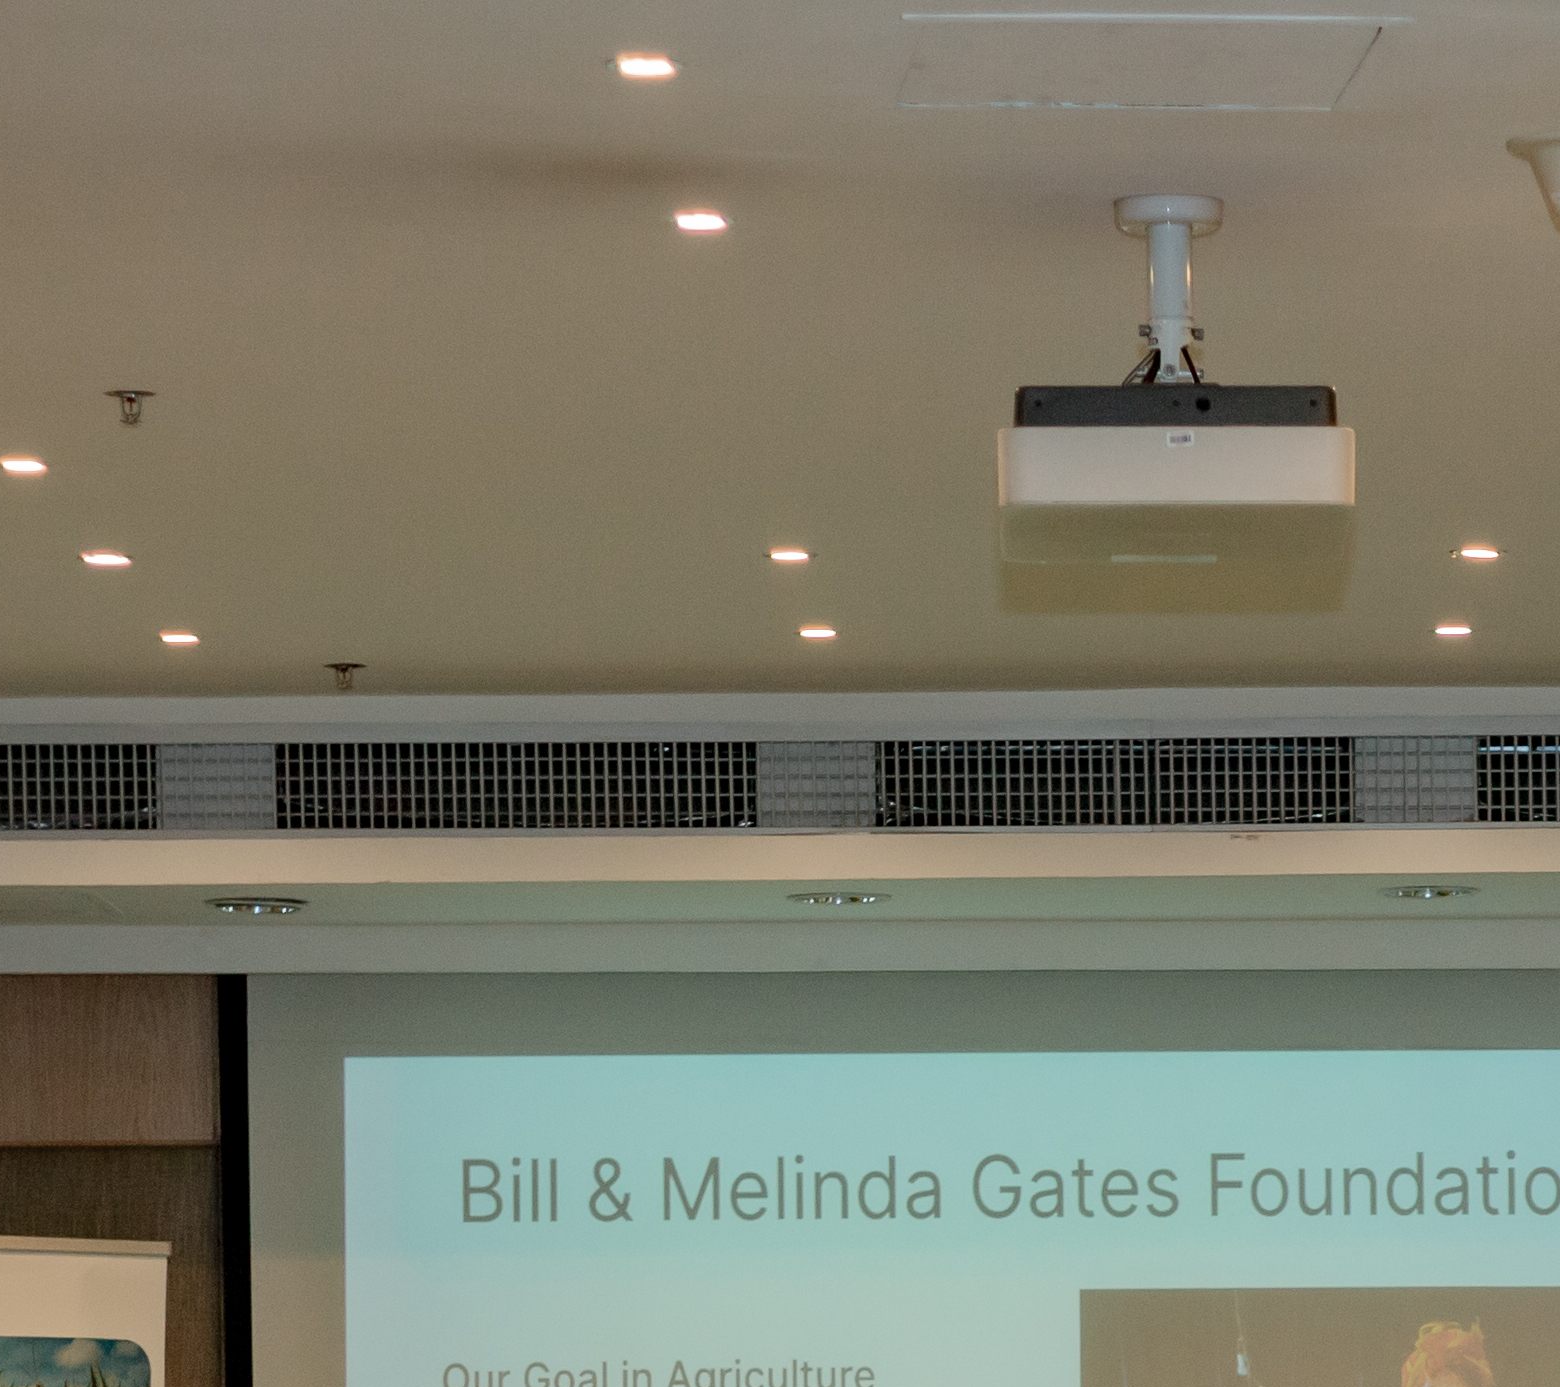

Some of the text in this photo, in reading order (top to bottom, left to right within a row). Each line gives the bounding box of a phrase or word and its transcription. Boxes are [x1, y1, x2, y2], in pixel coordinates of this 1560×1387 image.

[462, 1156, 558, 1223] Bill
[588, 1157, 633, 1222] &
[662, 1154, 942, 1221] Melinda
[973, 1153, 1179, 1218] Gates
